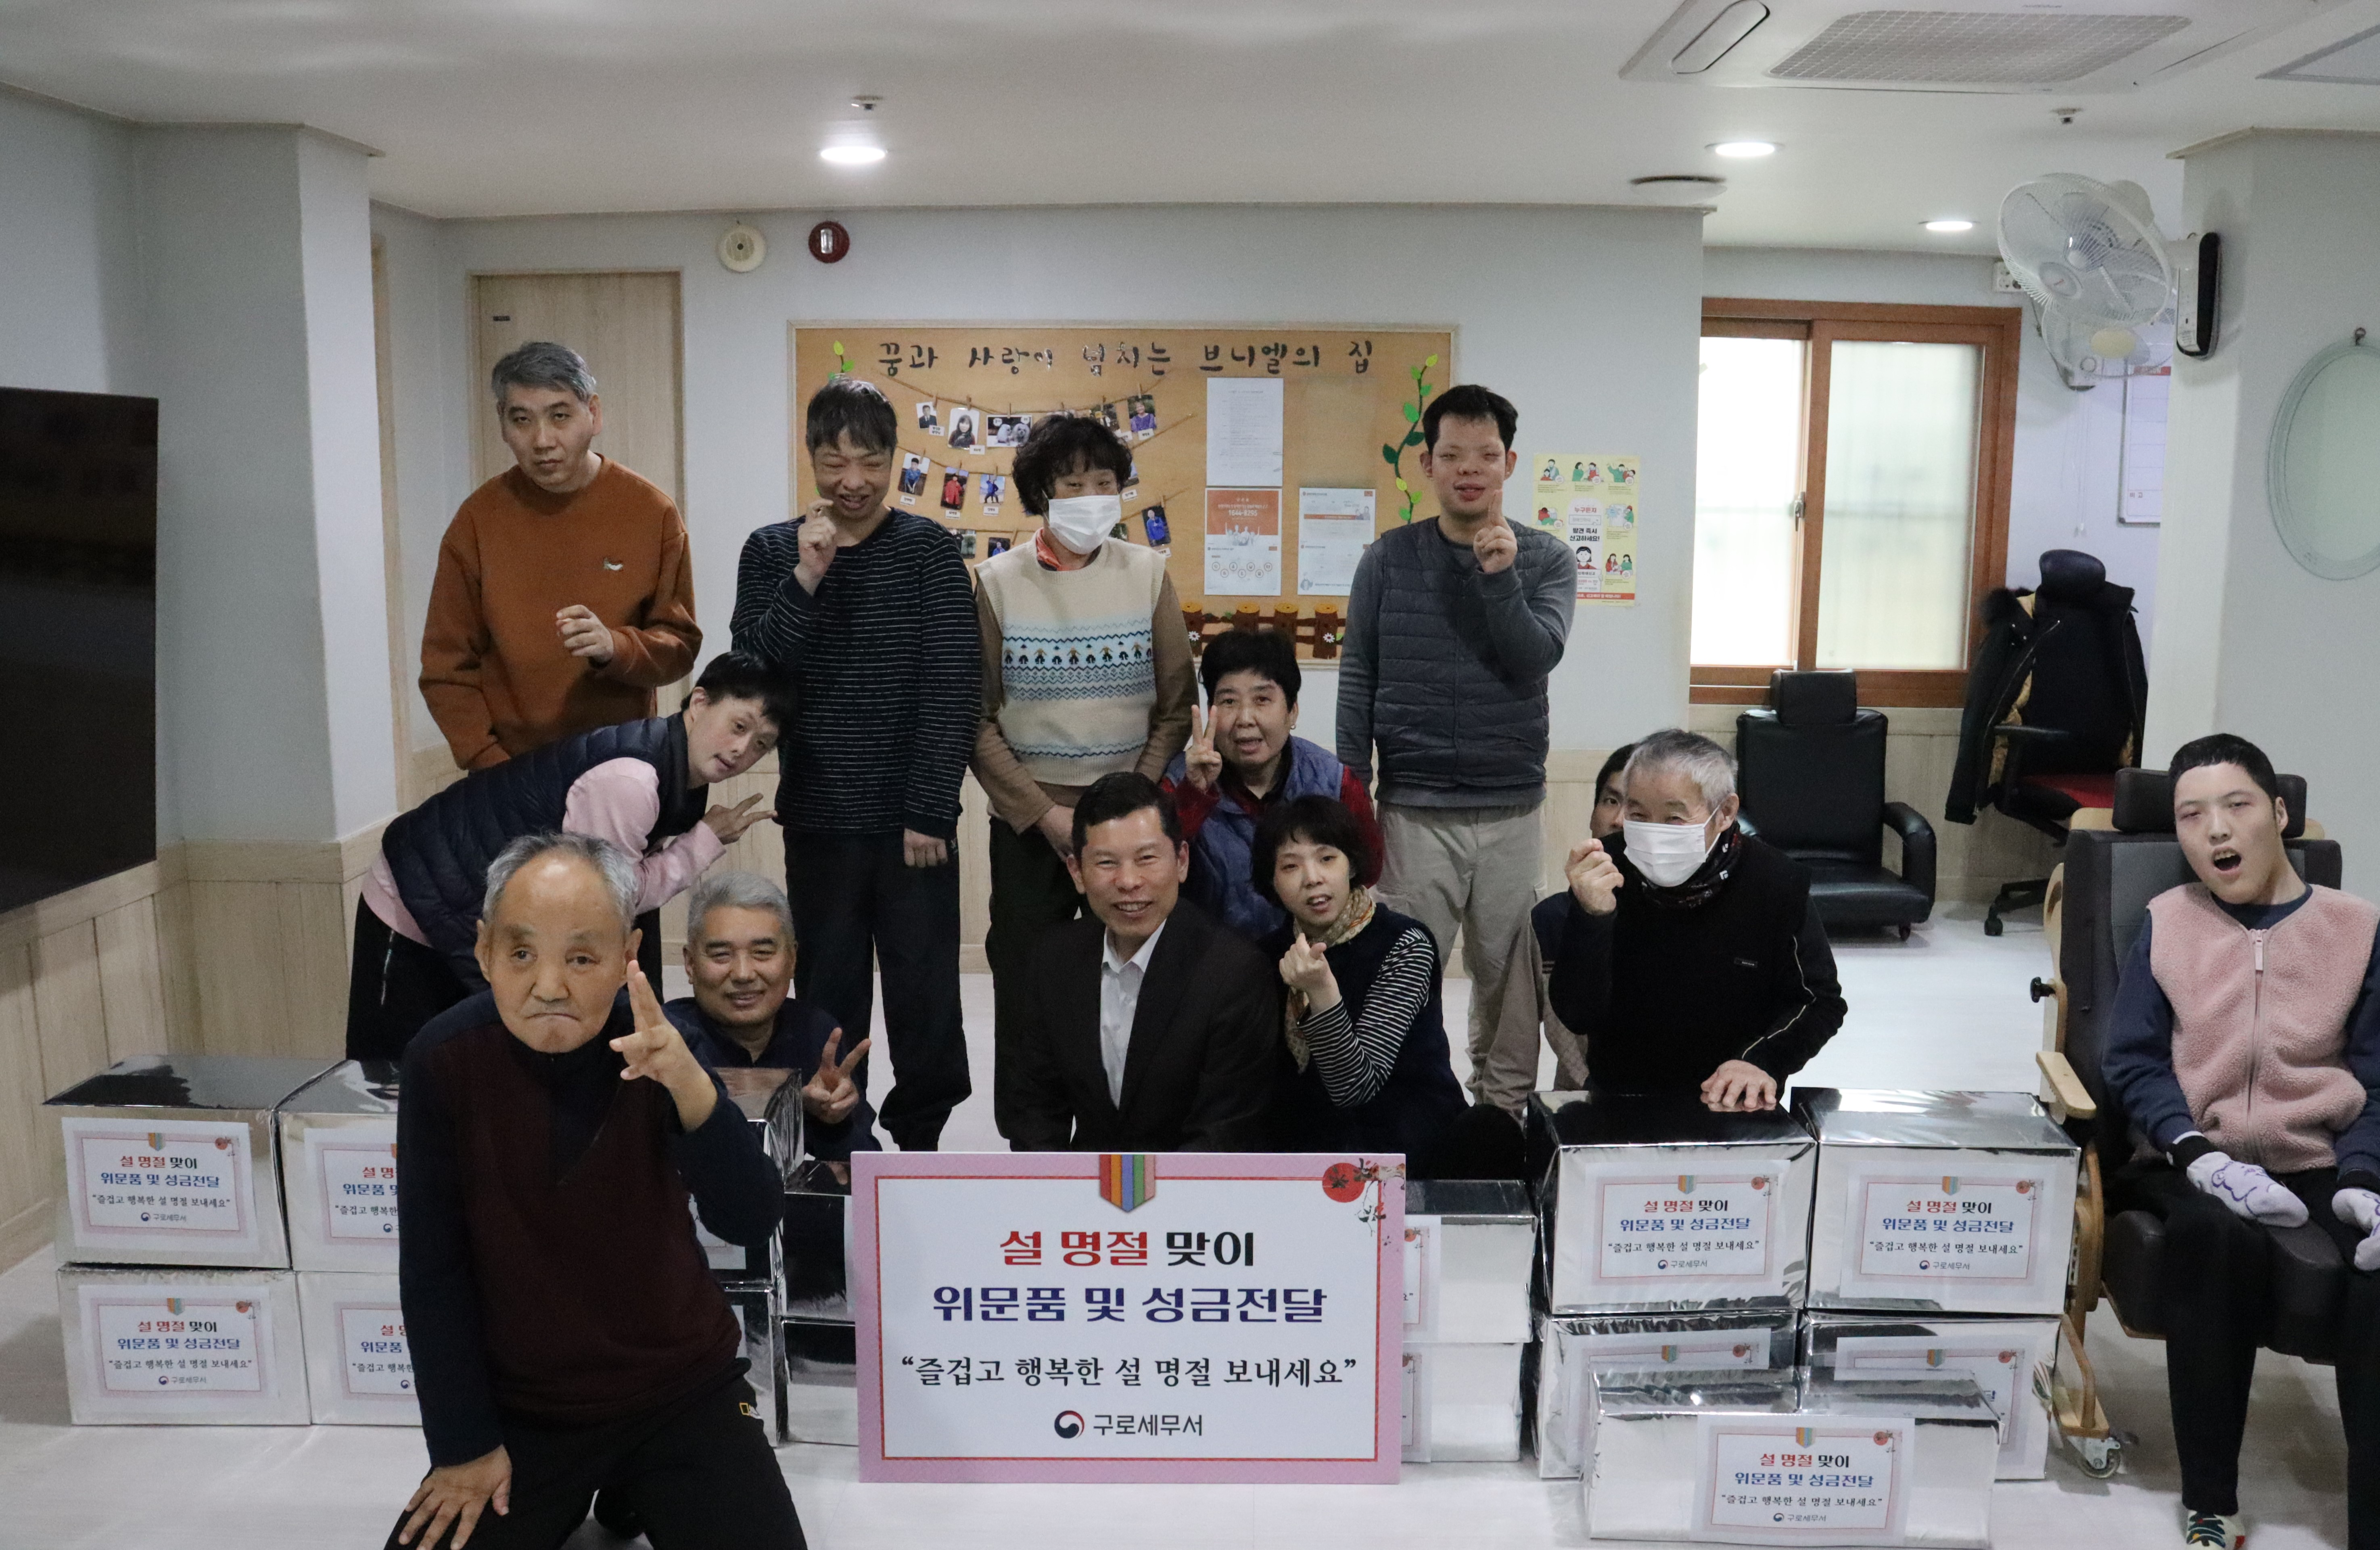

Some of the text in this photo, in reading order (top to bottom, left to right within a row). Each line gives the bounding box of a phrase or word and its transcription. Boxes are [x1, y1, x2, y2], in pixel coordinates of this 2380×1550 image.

[879, 340, 1372, 377] 꿈과 사랑이 넘치는 브니엘의 집
[120, 1156, 197, 1169] 설 명절 맞이
[363, 1167, 397, 1178] 설 명
[101, 1173, 219, 1187] 위문품 및 성금전달
[343, 1184, 384, 1195] 위문품
[92, 1194, 230, 1207] “즐겁고 행복한 설 명절 보내세요”
[1644, 1200, 1728, 1213] 설 명절 맞이
[1907, 1201, 1991, 1213] 설 명절 맞이
[335, 1205, 397, 1216] “즐겁고 행복한
[153, 1214, 186, 1222] 구로세무서
[1620, 1218, 1751, 1231] 위문품 및 성금전달
[1883, 1218, 2014, 1233] 위문품 및 성금전달
[1000, 1230, 1254, 1268] 설 명절 맞이
[1609, 1240, 1759, 1253] “즐겁고 행복한 설 명절 보내세요”
[1870, 1241, 2023, 1255] “즐겁고 행복한 설 명절 보내세요”
[1933, 1261, 1970, 1270] 구로세무서
[933, 1286, 1327, 1323] 위문품 및 성금전달
[138, 1321, 217, 1332] 설 명절 맞이
[381, 1325, 393, 1336] 설
[118, 1338, 240, 1349] 위문품 및 성금전달
[361, 1341, 402, 1353] 위문품
[109, 1360, 252, 1369] “즐겁고 행복한 설 명절 보내세요”
[352, 1363, 384, 1372] “즐겁고
[901, 1355, 1356, 1388] “즐겁고 행복한 설 명절 보내세요”
[1093, 1414, 1203, 1437] 구로세무서
[1760, 1454, 1849, 1468] 설 명절 맞이
[1735, 1473, 1874, 1487] 위문품 및 성금전달
[1722, 1494, 1882, 1507] “즐겁고 행복한 설 명절 보내세요”
